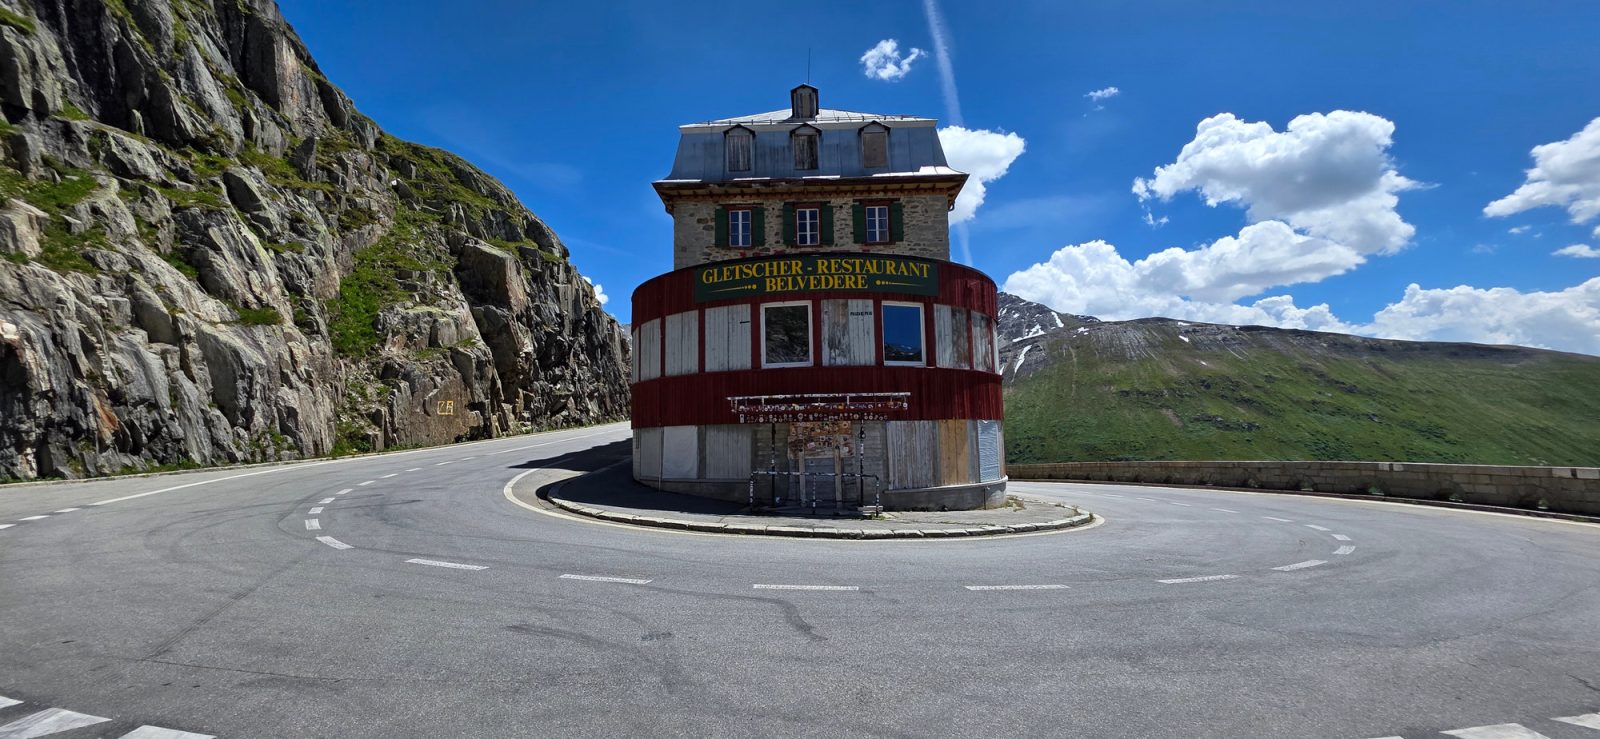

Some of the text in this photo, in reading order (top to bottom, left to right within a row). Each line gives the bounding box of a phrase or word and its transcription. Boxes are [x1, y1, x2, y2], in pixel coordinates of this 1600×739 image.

[702, 260, 803, 284] GLETSCHER
[817, 258, 930, 278] RESTAURANT
[765, 274, 869, 292] BELVEDERE
